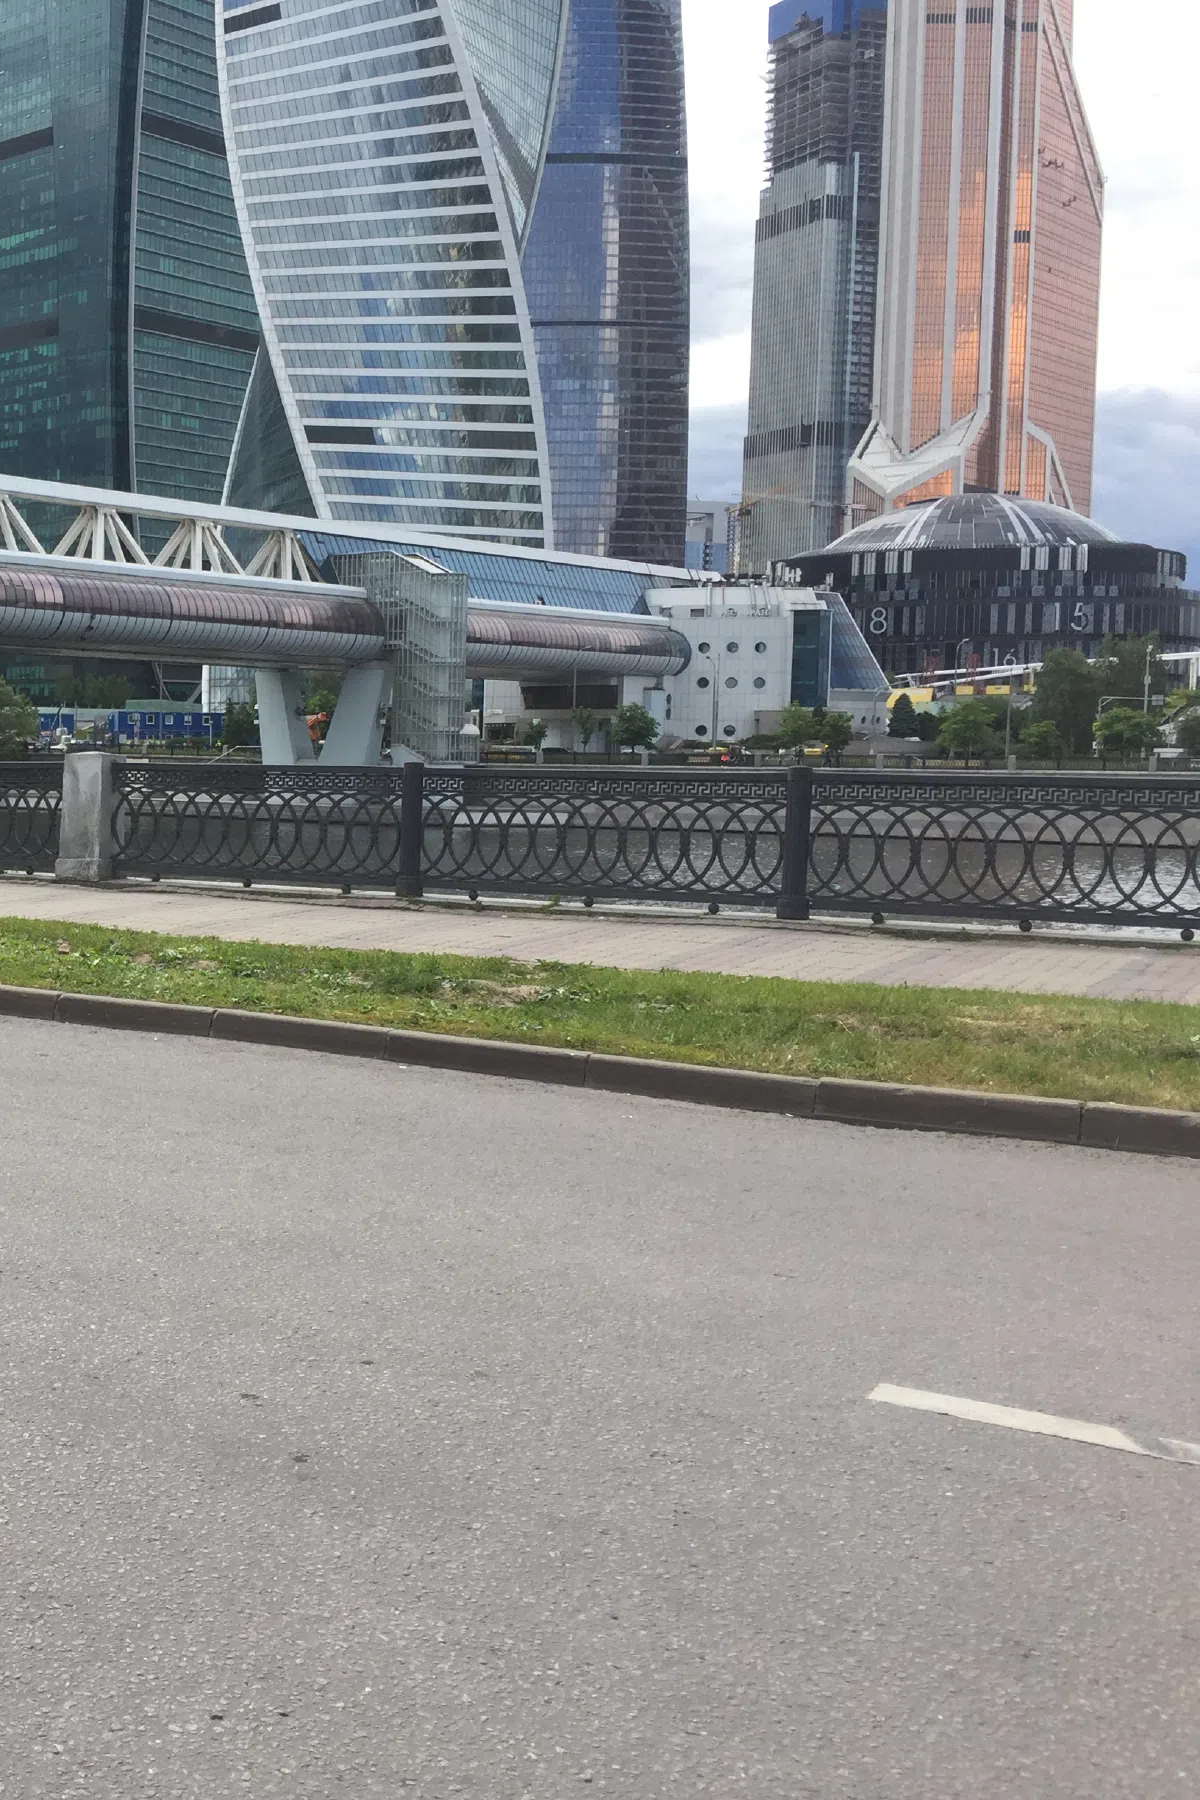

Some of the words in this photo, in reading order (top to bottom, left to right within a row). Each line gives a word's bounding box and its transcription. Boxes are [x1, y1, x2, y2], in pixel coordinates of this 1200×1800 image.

[870, 606, 887, 635] 8
[1054, 602, 1089, 631] 15
[992, 647, 1017, 667] 16
